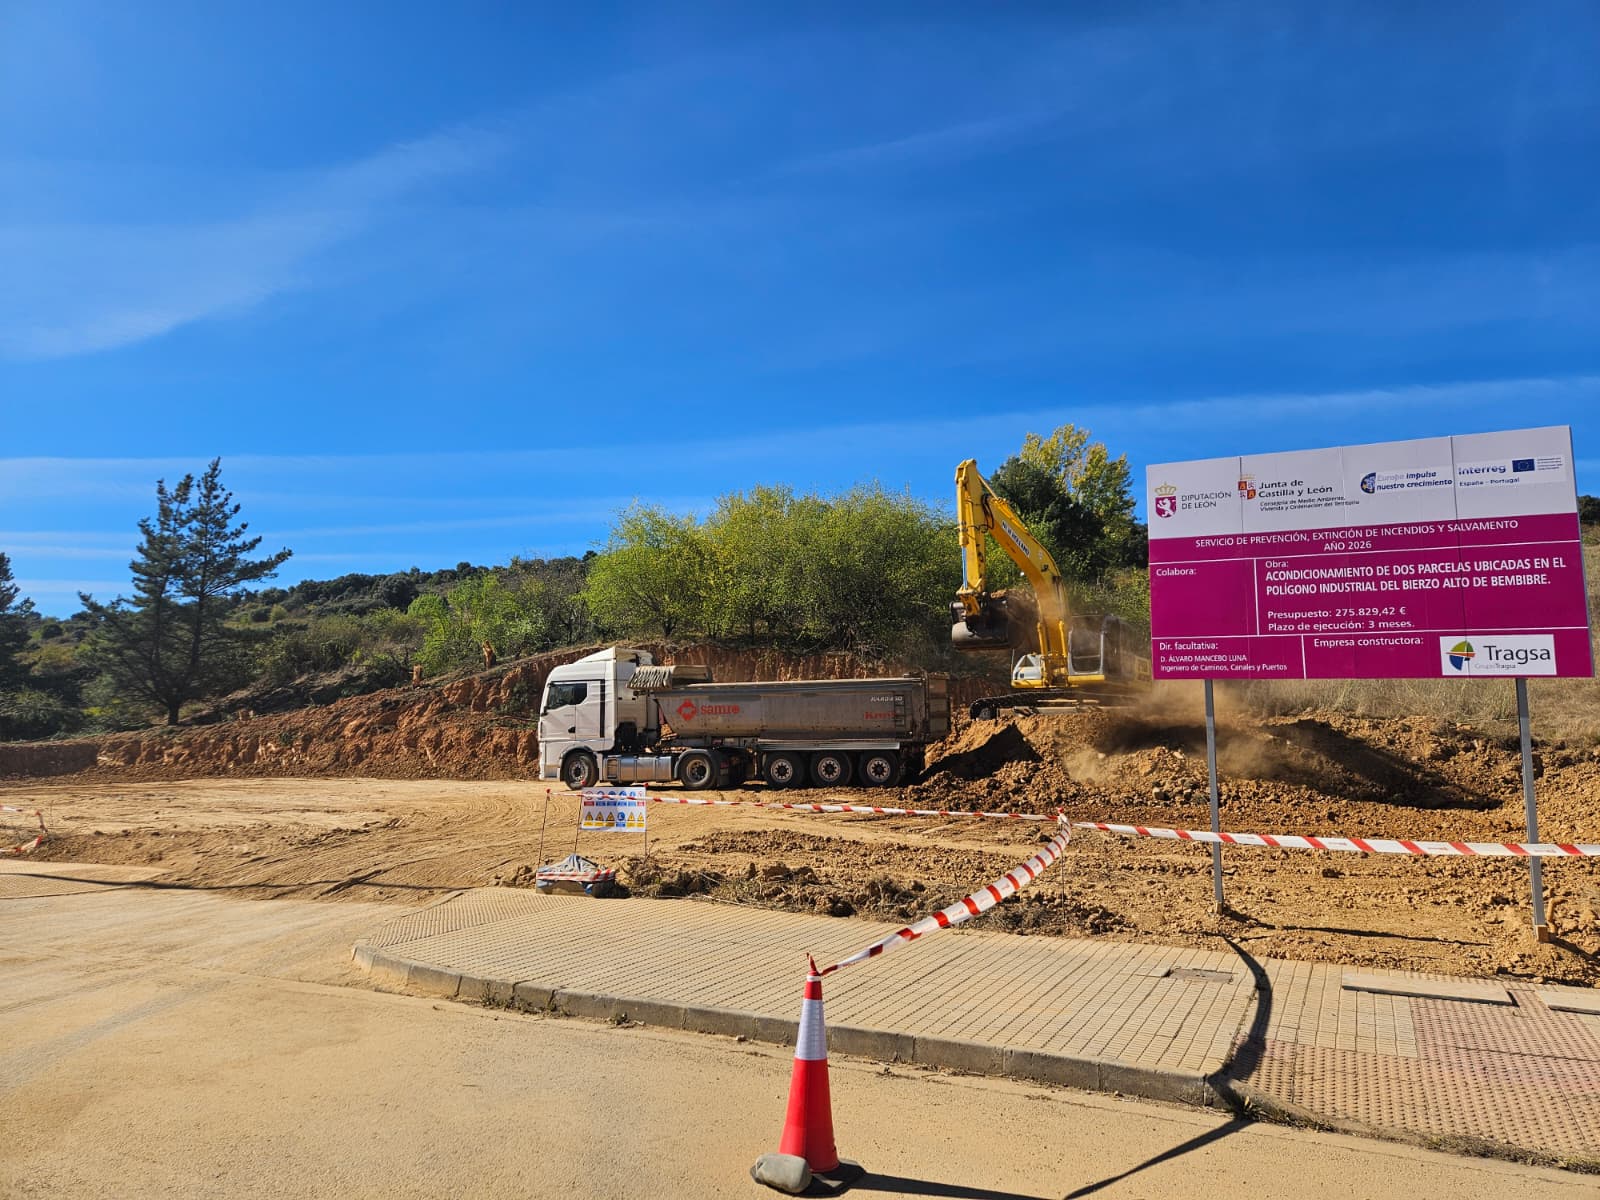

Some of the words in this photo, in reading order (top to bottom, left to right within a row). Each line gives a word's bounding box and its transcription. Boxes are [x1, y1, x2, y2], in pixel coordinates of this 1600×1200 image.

[1259, 481, 1287, 489] Junta
[1290, 479, 1304, 487] de
[1376, 483, 1405, 491] nuestro
[1406, 479, 1453, 488] crecimiento
[1490, 477, 1520, 485] Portugal
[1181, 491, 1232, 502] DIPUTACIÓN
[1258, 489, 1294, 498] Castilla
[1297, 489, 1304, 497] y
[1307, 485, 1333, 495] León
[1181, 502, 1192, 510] DE
[1194, 501, 1217, 509] LEÓN
[1195, 537, 1234, 548] SERVICIO
[1236, 537, 1248, 545] DE
[1250, 532, 1310, 544] PREVENCIÓN,
[1312, 528, 1363, 541] EXTINCIÓN
[1365, 528, 1378, 538] DE
[1381, 524, 1435, 536] INCENDIOS
[1437, 524, 1445, 533] Y
[1447, 519, 1519, 532] SALVAMENTO
[1323, 540, 1346, 552] AÑO
[1347, 540, 1372, 550] 2026
[1265, 560, 1289, 569] Obra:
[1265, 566, 1374, 581] ACONDICIONAMIENTO
[1376, 565, 1390, 576] DE
[1393, 564, 1416, 576] DOS
[1418, 561, 1471, 574] PARCELAS
[1474, 558, 1531, 572] UBICADAS
[1534, 558, 1549, 569] EN
[1552, 557, 1567, 568] EL
[1156, 567, 1197, 577] Colabora:
[1266, 582, 1317, 596] POLÍGONO
[1319, 581, 1378, 593] INDUSTRIAL
[1380, 580, 1400, 591] DEL
[1402, 578, 1440, 590] BIERZO
[1442, 577, 1470, 588] ALTO
[1473, 576, 1488, 587] DE
[1491, 573, 1551, 586] BEMBIBRE.
[1267, 609, 1332, 620] Presupuesto:
[1335, 606, 1396, 617] 275.829,42
[1399, 606, 1407, 615] €
[1268, 623, 1295, 631] Plazo
[1297, 622, 1311, 631] de
[1313, 620, 1365, 632] ejecución:
[1368, 620, 1375, 629] 3
[1378, 620, 1415, 628] meses.
[1159, 642, 1173, 651] Dir.
[1174, 641, 1219, 651] facultativa:
[1313, 638, 1355, 649] Empresa
[1357, 636, 1424, 646] constructora:
[1168, 654, 1193, 663] ÁLVARO
[1194, 654, 1227, 662] MANCEBO
[1229, 654, 1247, 662] LUNA
[1483, 645, 1551, 665] Tragsa
[1160, 664, 1189, 672] Ingeniero
[1200, 664, 1229, 672] Caminos,
[1230, 663, 1255, 671] Canales
[1262, 663, 1287, 671] Puertos
